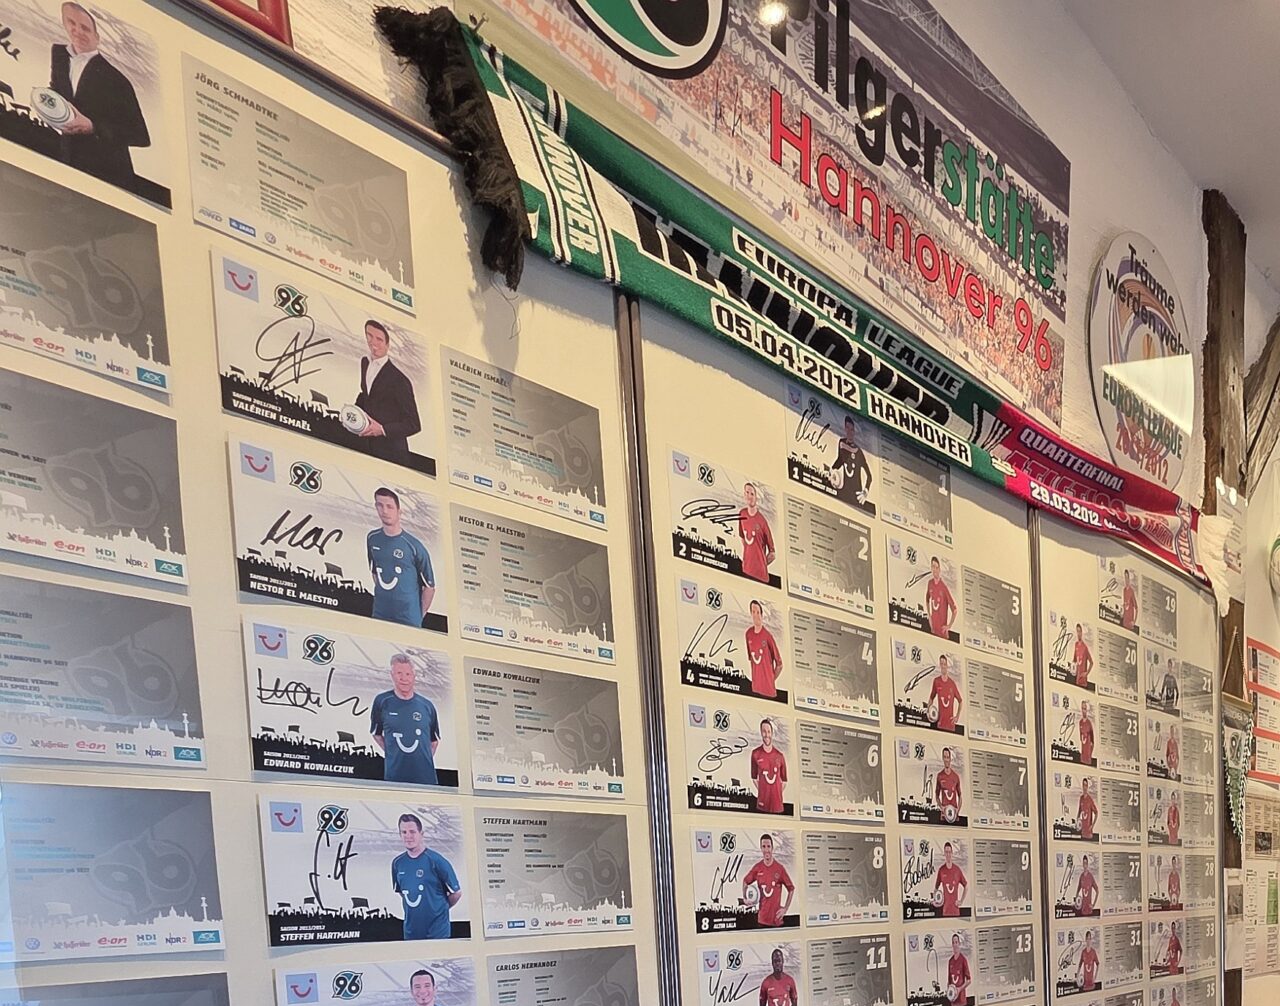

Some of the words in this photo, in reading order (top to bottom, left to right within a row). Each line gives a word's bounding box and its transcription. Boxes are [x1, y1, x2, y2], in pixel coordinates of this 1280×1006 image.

[195, 72, 220, 92] JÖRG
[223, 86, 280, 122] SCHMADTKE
[770, 86, 1002, 329] Hannover
[1014, 298, 1053, 372] 96
[1128, 243, 1175, 315] Träume
[277, 287, 306, 316] 96
[1106, 269, 1156, 334] werden
[737, 234, 858, 335] EUROPA
[866, 320, 966, 400] LEAGUE
[449, 359, 482, 379] VALÉRIEN
[482, 371, 509, 387] ISMAËL
[715, 301, 858, 405] 05.04.2012
[869, 391, 971, 463] HANNOVER
[232, 399, 278, 421] VALÉRIEN
[279, 414, 312, 432] ISMAËL
[1018, 427, 1125, 493] QUARTERFINAL
[292, 465, 321, 492] 96
[792, 467, 800, 480] 1
[939, 474, 948, 496] 1
[1030, 481, 1103, 527] 29.03.2012
[458, 515, 486, 528] NESTOR
[486, 523, 495, 531] EL
[496, 525, 526, 539] MAESTRO
[678, 542, 687, 557] 2
[857, 536, 869, 561] 2
[249, 581, 284, 596] NESTOR
[286, 589, 297, 599] EL
[299, 591, 339, 607] MAESTRO
[1012, 599, 1020, 616] 3
[1165, 595, 1176, 614] 19
[892, 609, 899, 622] 3
[305, 637, 333, 661] 96
[862, 641, 874, 666] 4
[1125, 647, 1137, 667] 20
[472, 667, 501, 678] EDWARD
[503, 673, 541, 684] KOWALCZUK
[686, 669, 695, 683] 4
[1202, 676, 1212, 693] 21
[1015, 683, 1024, 702] 5
[1126, 718, 1138, 736] 23
[867, 743, 879, 768] 6
[1204, 738, 1214, 754] 24
[263, 758, 302, 769] EDWARD
[304, 762, 355, 774] KOWALCZUK
[1018, 766, 1027, 786] 7
[693, 792, 702, 807] 6
[1127, 789, 1139, 808] 25
[1204, 800, 1215, 816] 26
[320, 808, 347, 831] 96
[483, 817, 511, 826] STEFFEN
[872, 846, 885, 870] 8
[1021, 851, 1030, 871] 9
[1129, 861, 1141, 878] 27
[1205, 861, 1215, 877] 28
[701, 917, 710, 931] 8
[1205, 922, 1216, 938] 33
[280, 932, 315, 942] STEFFEN
[317, 930, 361, 940] HARTMANN
[1015, 933, 1032, 954] 13
[1130, 929, 1142, 946] 31
[496, 962, 520, 972] CARLOS
[521, 960, 558, 970] HERNANDEZ
[866, 945, 888, 971] 11
[333, 975, 362, 999] 96
[1206, 982, 1216, 998] 35
